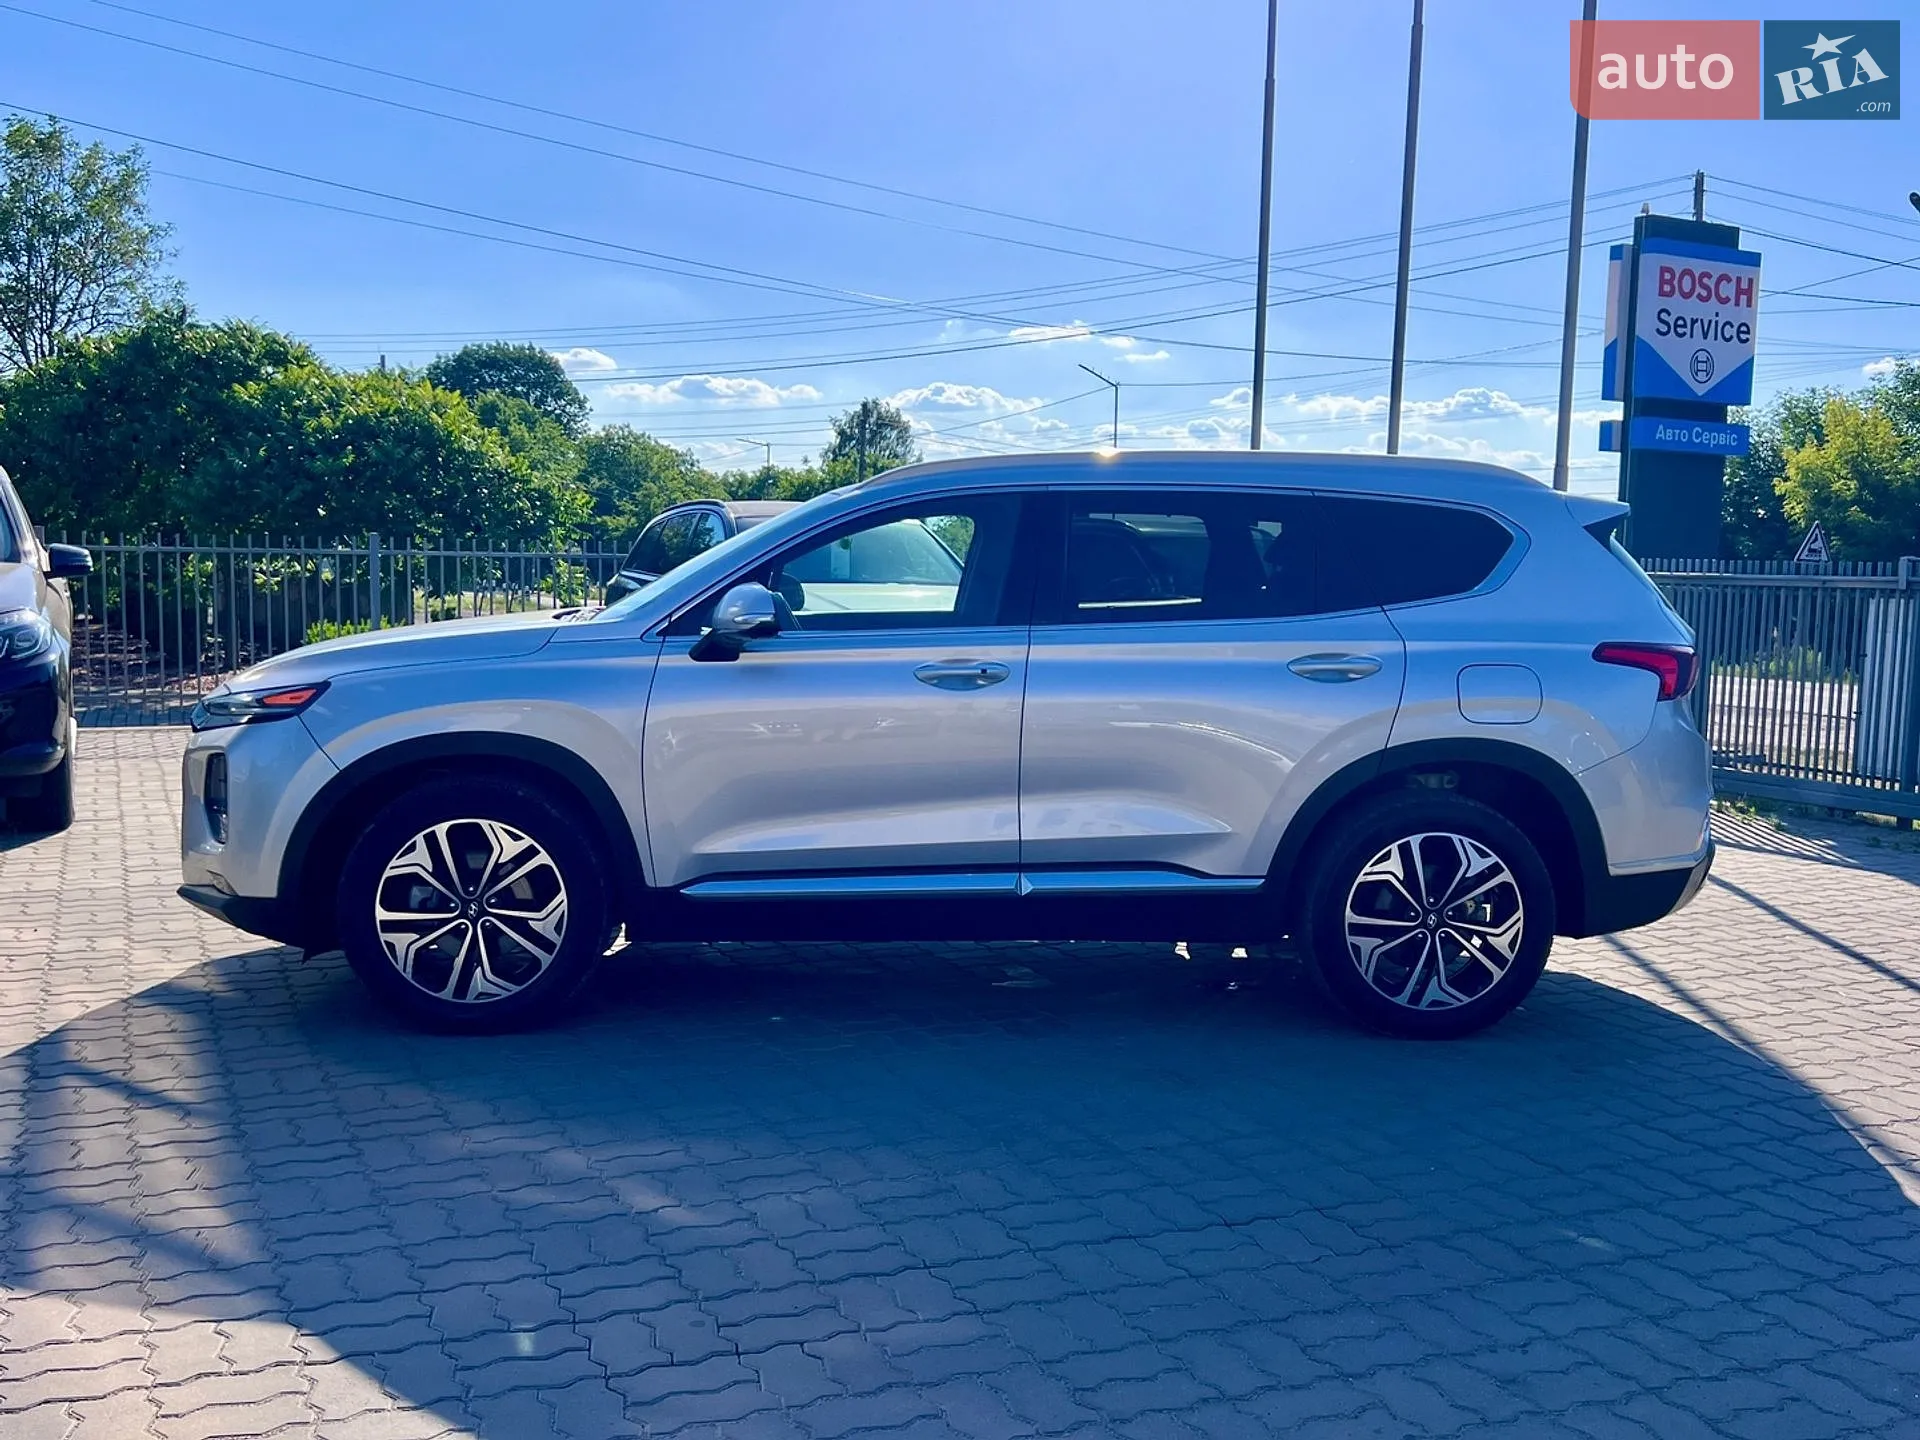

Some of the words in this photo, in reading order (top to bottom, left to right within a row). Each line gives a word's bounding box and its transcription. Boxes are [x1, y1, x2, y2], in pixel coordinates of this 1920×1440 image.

[1658, 265, 1753, 308] BOSCH
[1655, 307, 1751, 344] Service
[1655, 423, 1688, 442] Авто
[1692, 426, 1738, 447] Сервіс
